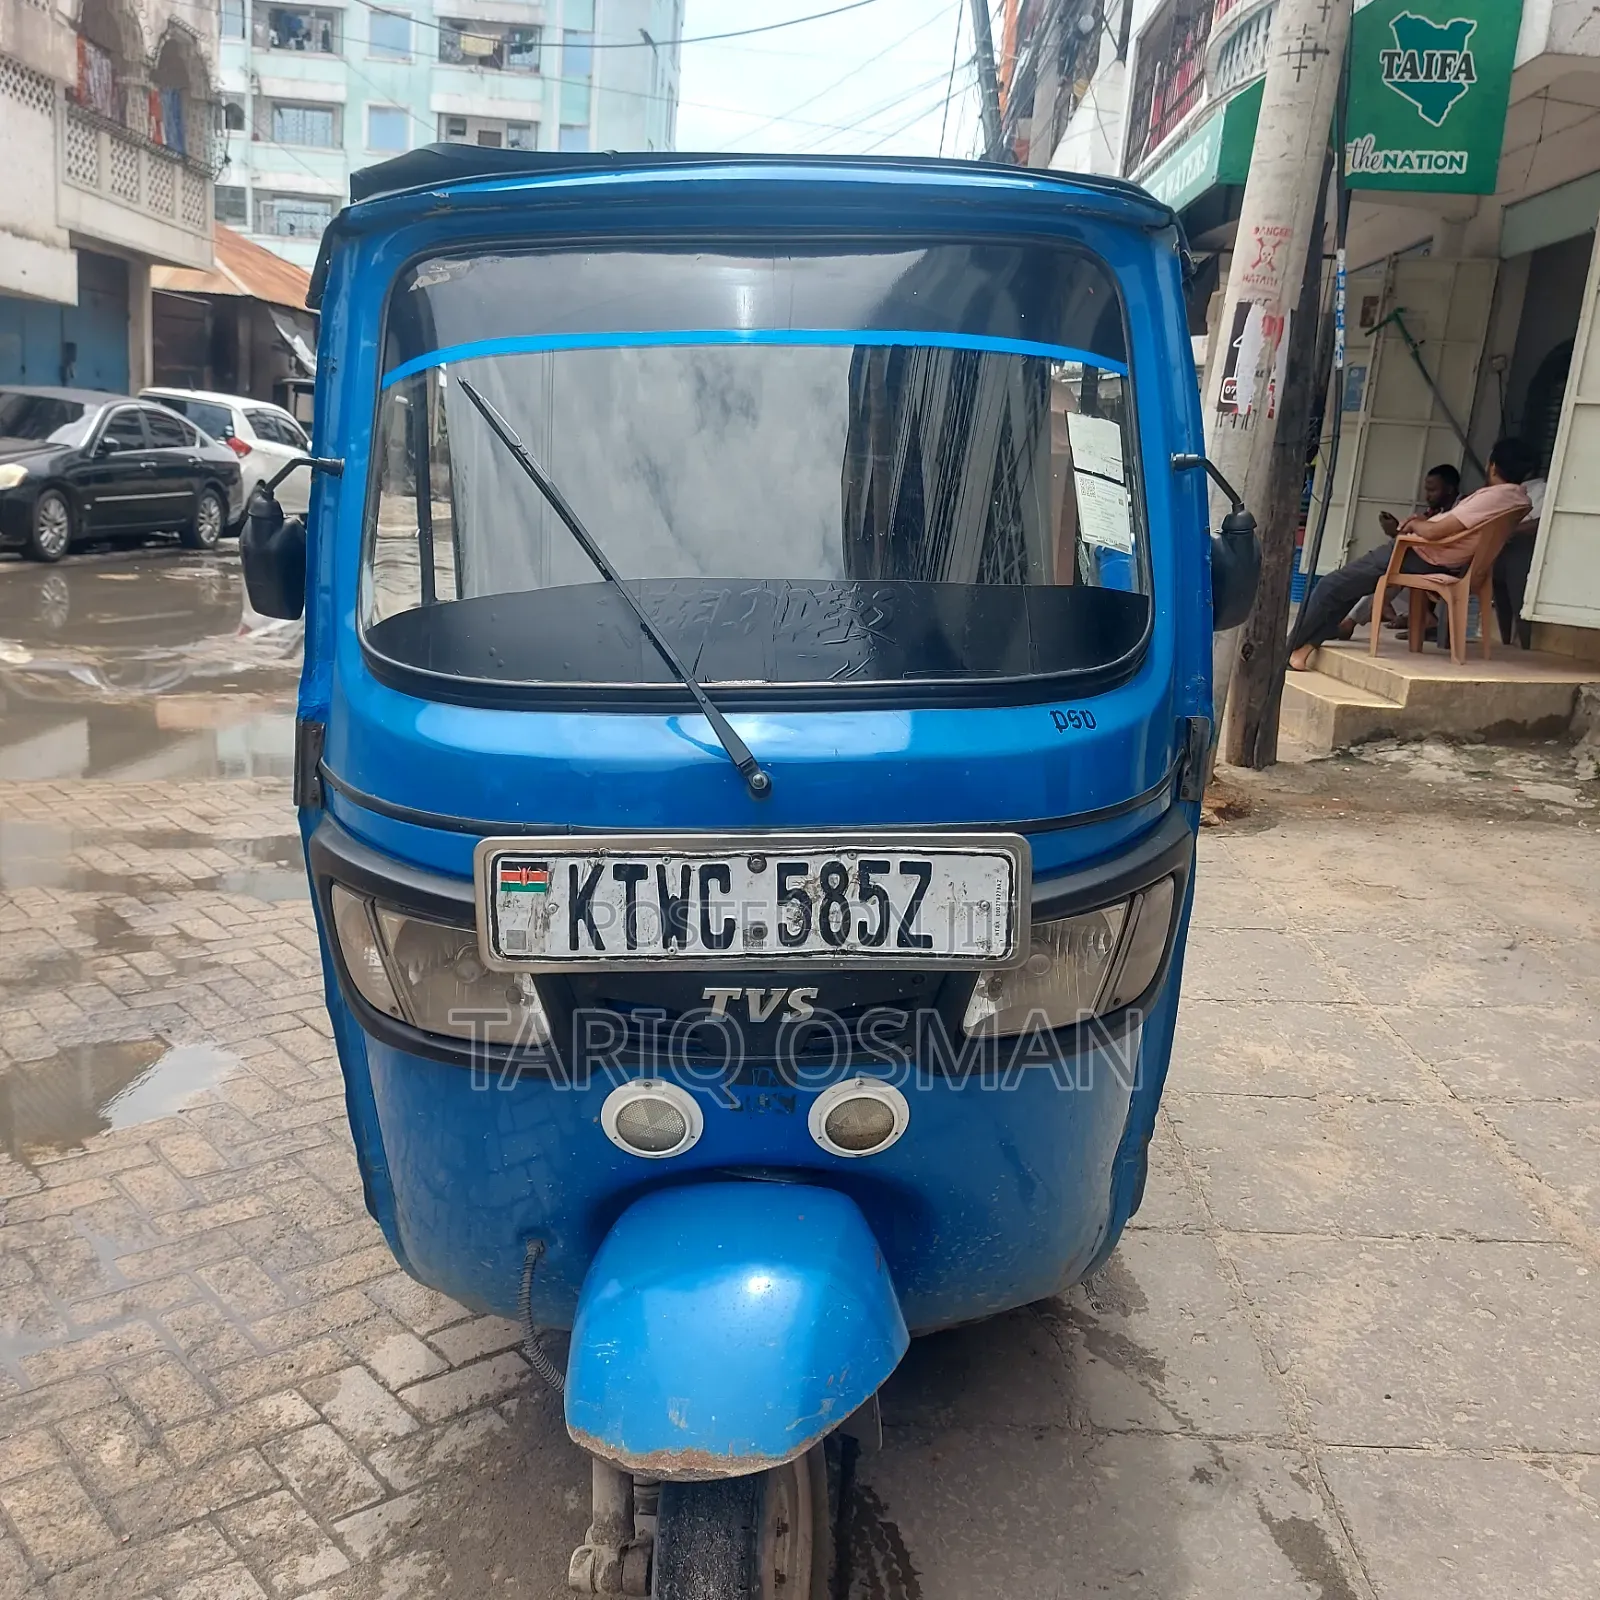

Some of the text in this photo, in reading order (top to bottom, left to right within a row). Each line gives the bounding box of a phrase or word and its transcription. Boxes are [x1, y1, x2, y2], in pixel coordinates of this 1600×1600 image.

[1380, 50, 1477, 83] TAIFA
[568, 860, 933, 951] KTWC 585Z
[702, 987, 819, 1023] TVS
